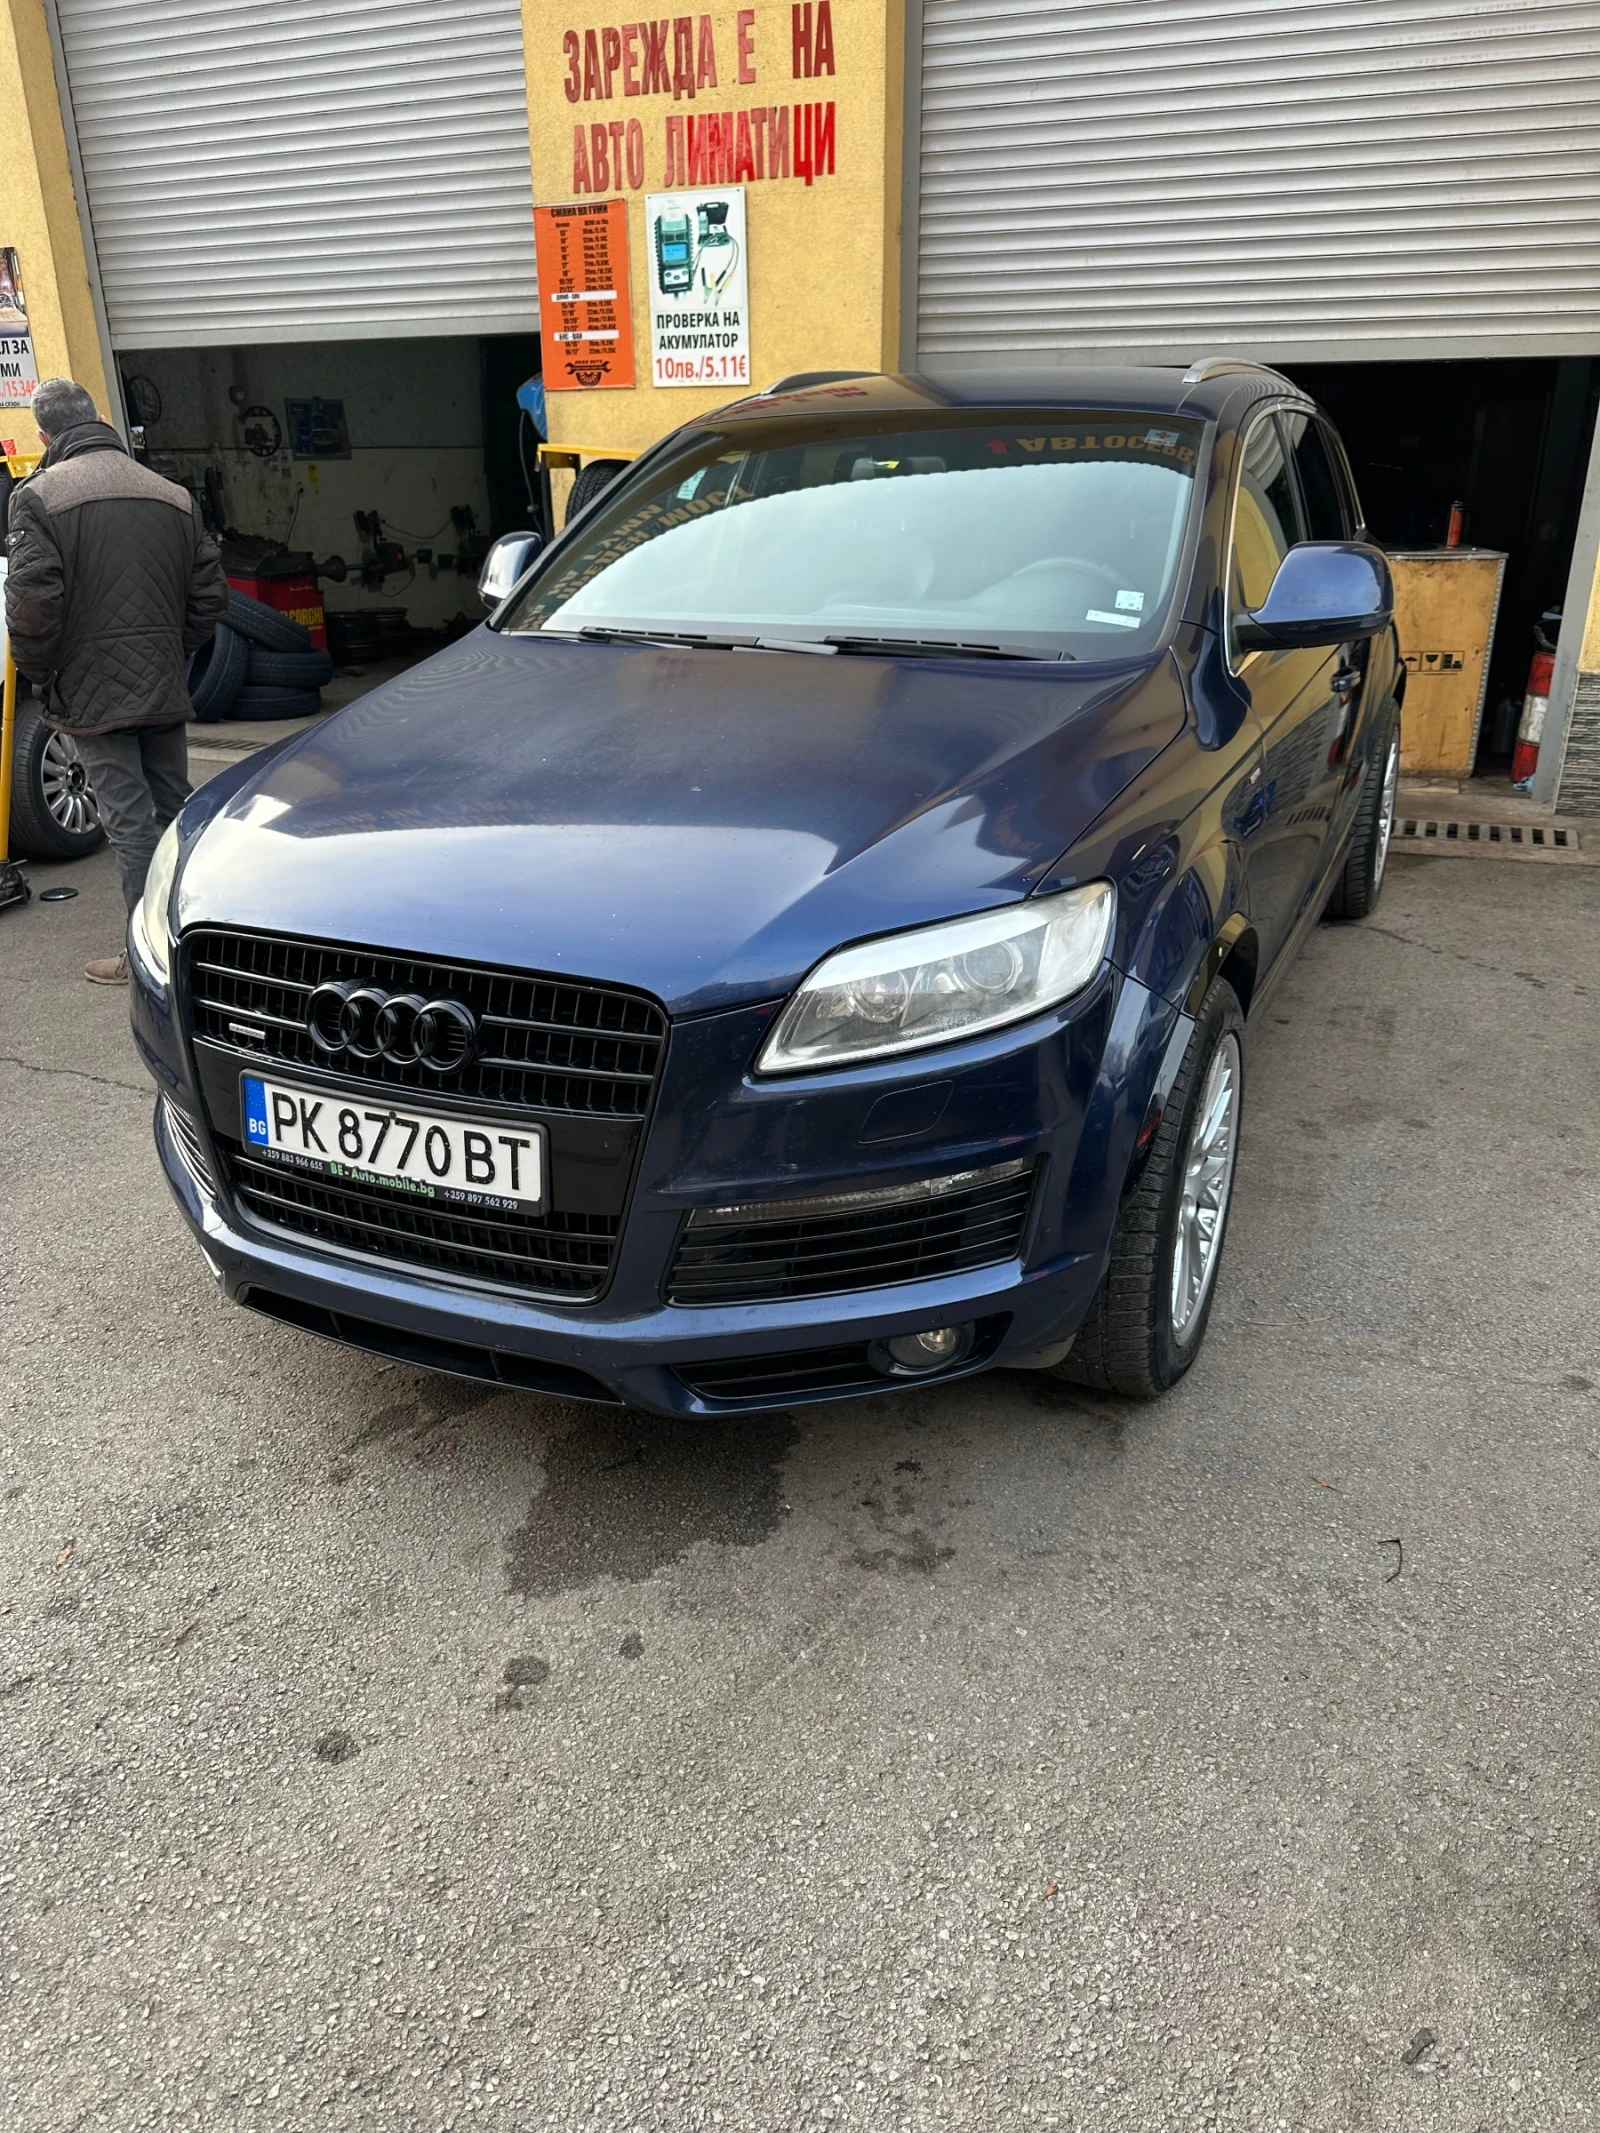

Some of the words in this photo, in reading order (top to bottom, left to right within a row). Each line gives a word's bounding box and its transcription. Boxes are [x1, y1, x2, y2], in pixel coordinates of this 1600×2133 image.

[563, 14, 718, 104] ЗАРЕЖДА
[737, 9, 757, 85] Е
[792, 0, 836, 79] НА
[573, 118, 644, 194] АВТО
[664, 101, 836, 188] ЛИМАТИЦИ
[656, 312, 720, 329] ПРОВЕРКА
[723, 311, 740, 327] НА
[0, 340, 10, 355] Л
[12, 339, 29, 355] ЗА
[659, 333, 739, 350] АКУМУЛАТОР
[0, 362, 22, 378] МИ
[656, 354, 746, 379] 10лв./5.11€
[0, 380, 36, 398] ./15.34€
[249, 1118, 267, 1136] BG
[271, 1091, 329, 1154] PK
[337, 1108, 452, 1177] 8770
[463, 1130, 531, 1191] BT
[262, 1149, 280, 1160] +359
[295, 1156, 309, 1167] 966
[310, 1160, 323, 1171] 655
[444, 1190, 466, 1201] +359
[467, 1193, 483, 1204] 897
[484, 1197, 501, 1207] 562
[502, 1200, 518, 1210] 929
